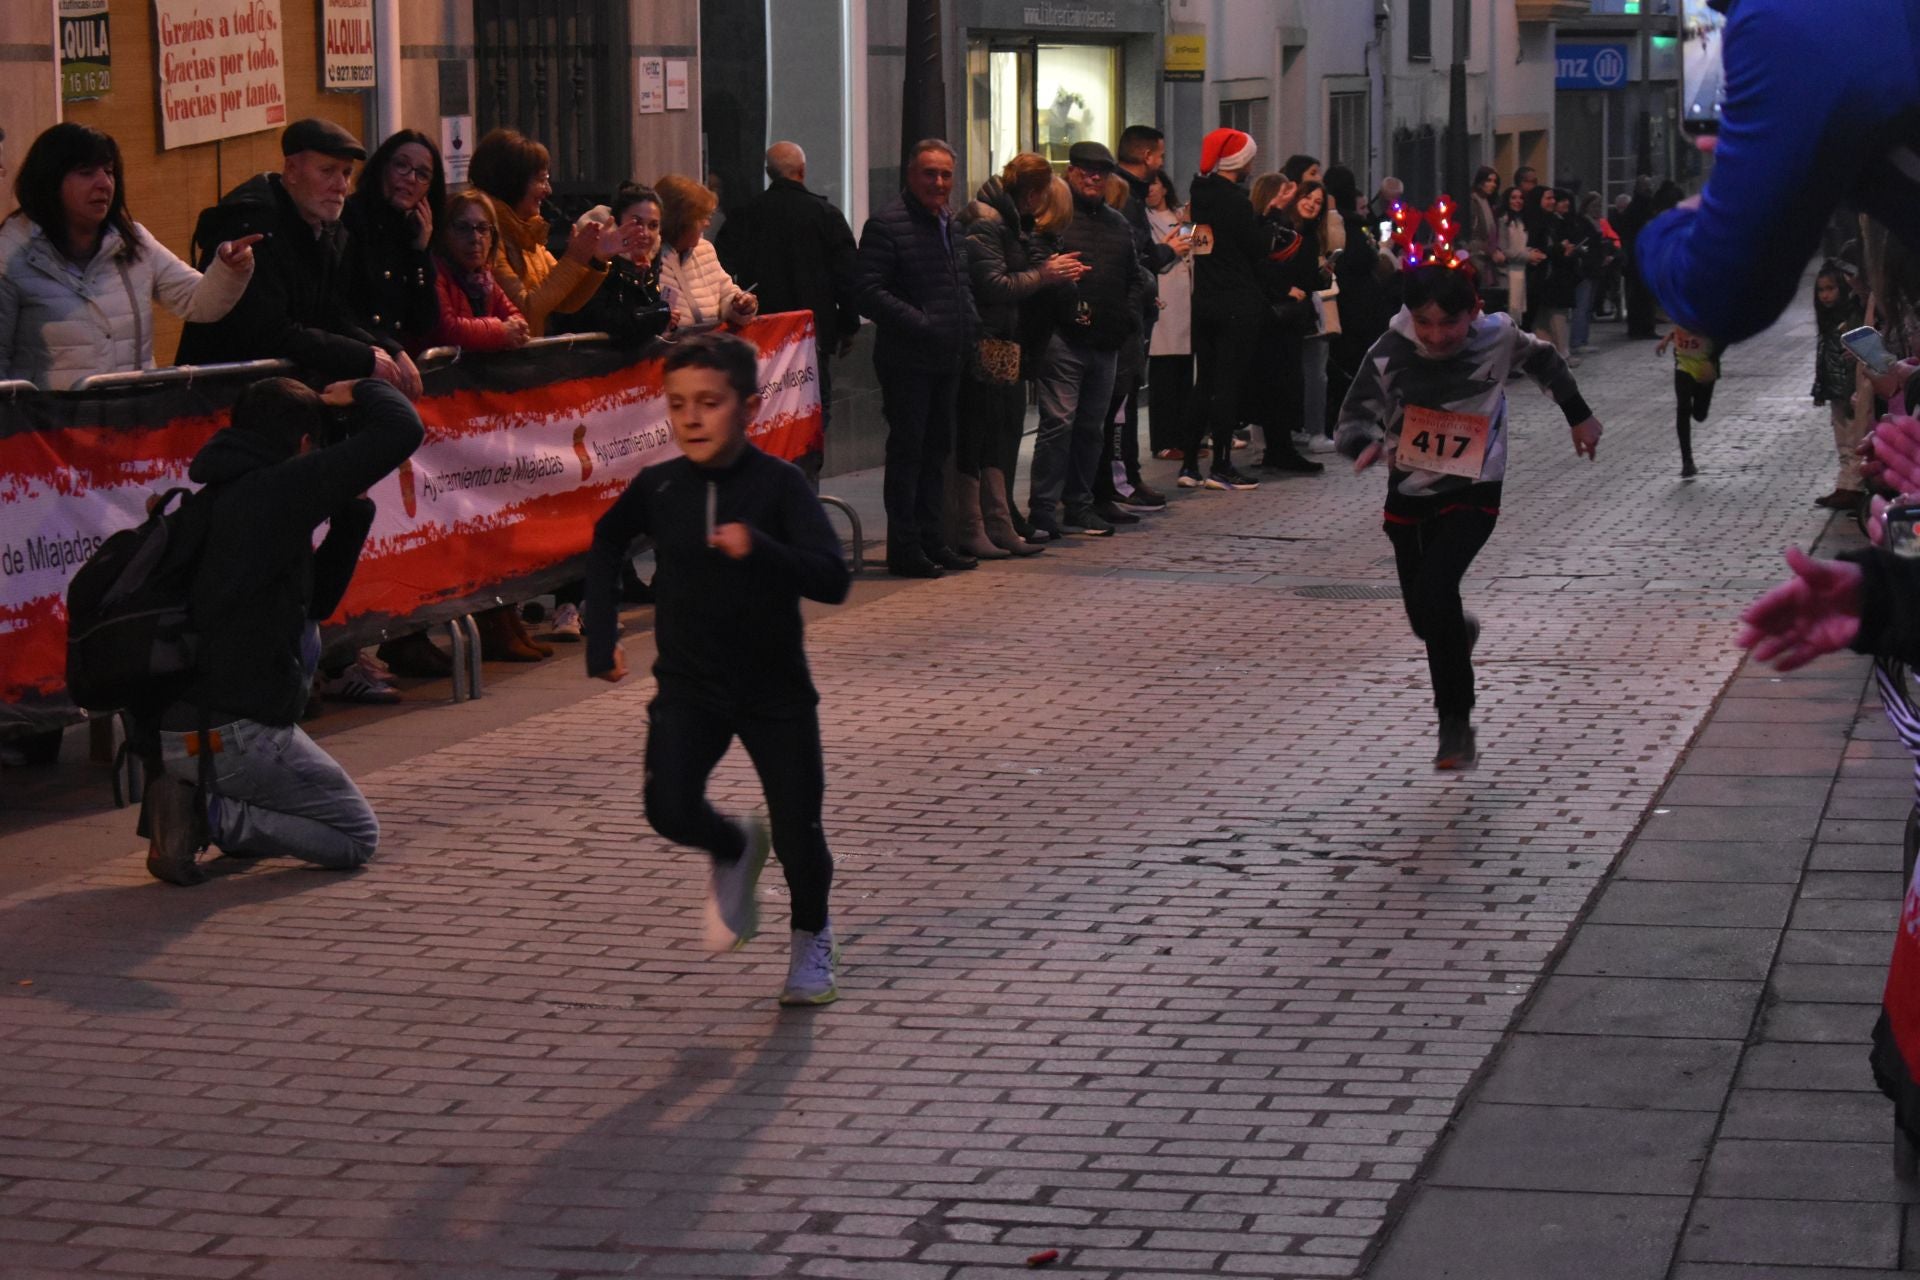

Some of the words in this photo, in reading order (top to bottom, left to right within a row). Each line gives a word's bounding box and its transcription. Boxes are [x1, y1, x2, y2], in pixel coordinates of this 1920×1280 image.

[60, 20, 109, 60] QUILA
[161, 8, 214, 46] Gracias
[219, 16, 229, 37] a
[327, 19, 373, 55] ALQUILA
[70, 73, 81, 92] 16
[85, 72, 96, 91] 16
[98, 70, 110, 90] 20
[164, 47, 216, 84] Gracias
[220, 53, 243, 86] por
[247, 39, 279, 71] todo.
[165, 85, 217, 122] Gracias
[220, 89, 243, 122] por
[246, 78, 281, 108] tanto.
[592, 429, 655, 467] Ayuntamiento
[655, 424, 667, 446] de
[1411, 430, 1471, 459] 417
[494, 461, 512, 485] de
[512, 451, 565, 485] Miajadas
[2, 543, 24, 576] de
[27, 530, 103, 576] Miajadas
